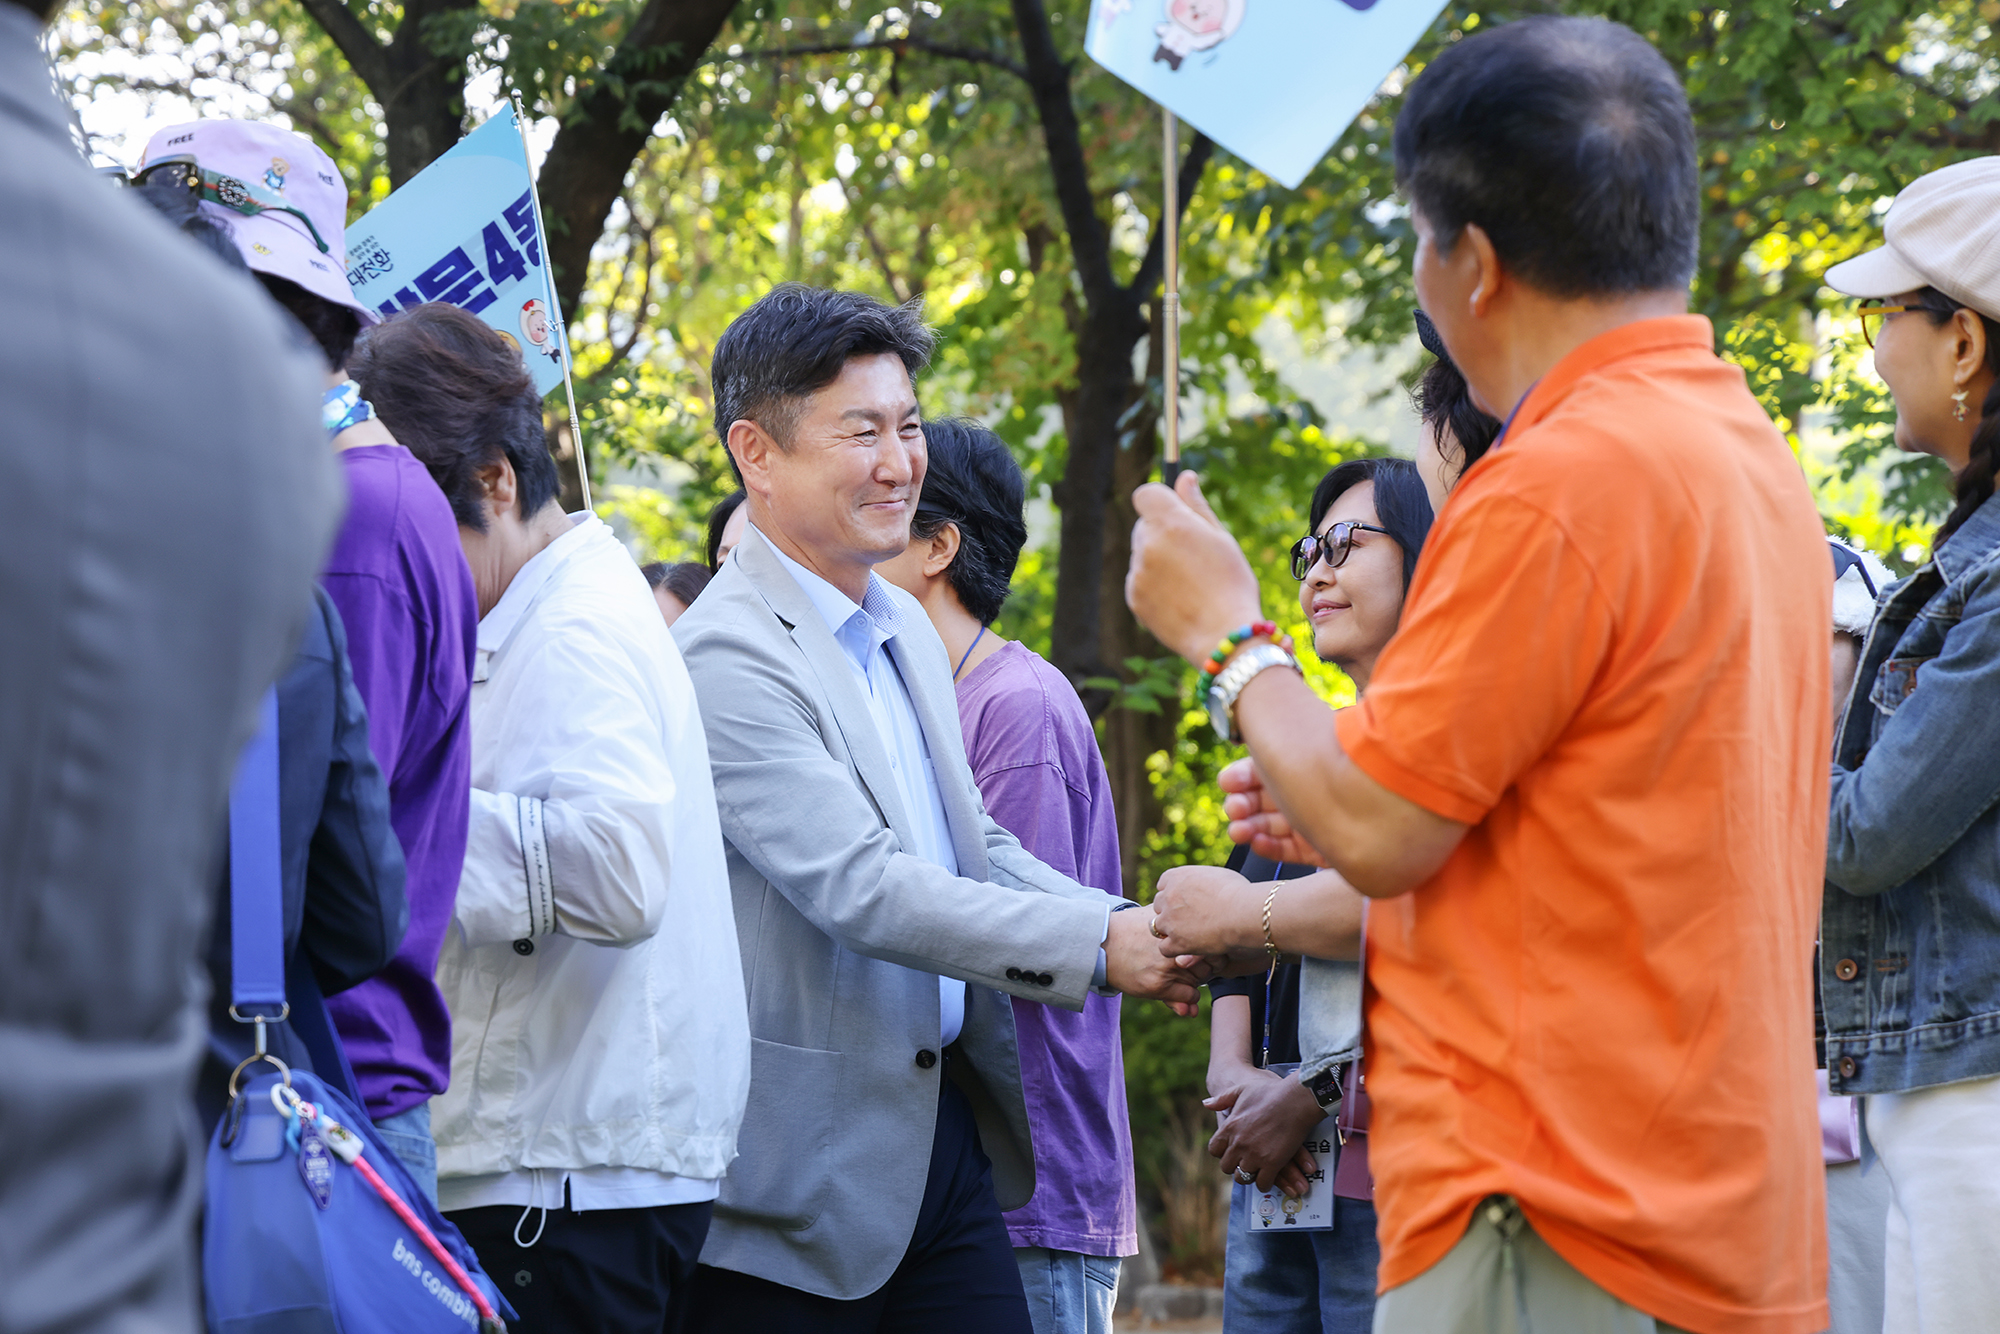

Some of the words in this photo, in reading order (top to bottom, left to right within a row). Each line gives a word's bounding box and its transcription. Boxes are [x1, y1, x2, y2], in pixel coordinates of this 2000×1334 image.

[346, 248, 394, 286] 대전환
[1306, 1139, 1331, 1153] 크숍
[392, 1237, 423, 1278] bns
